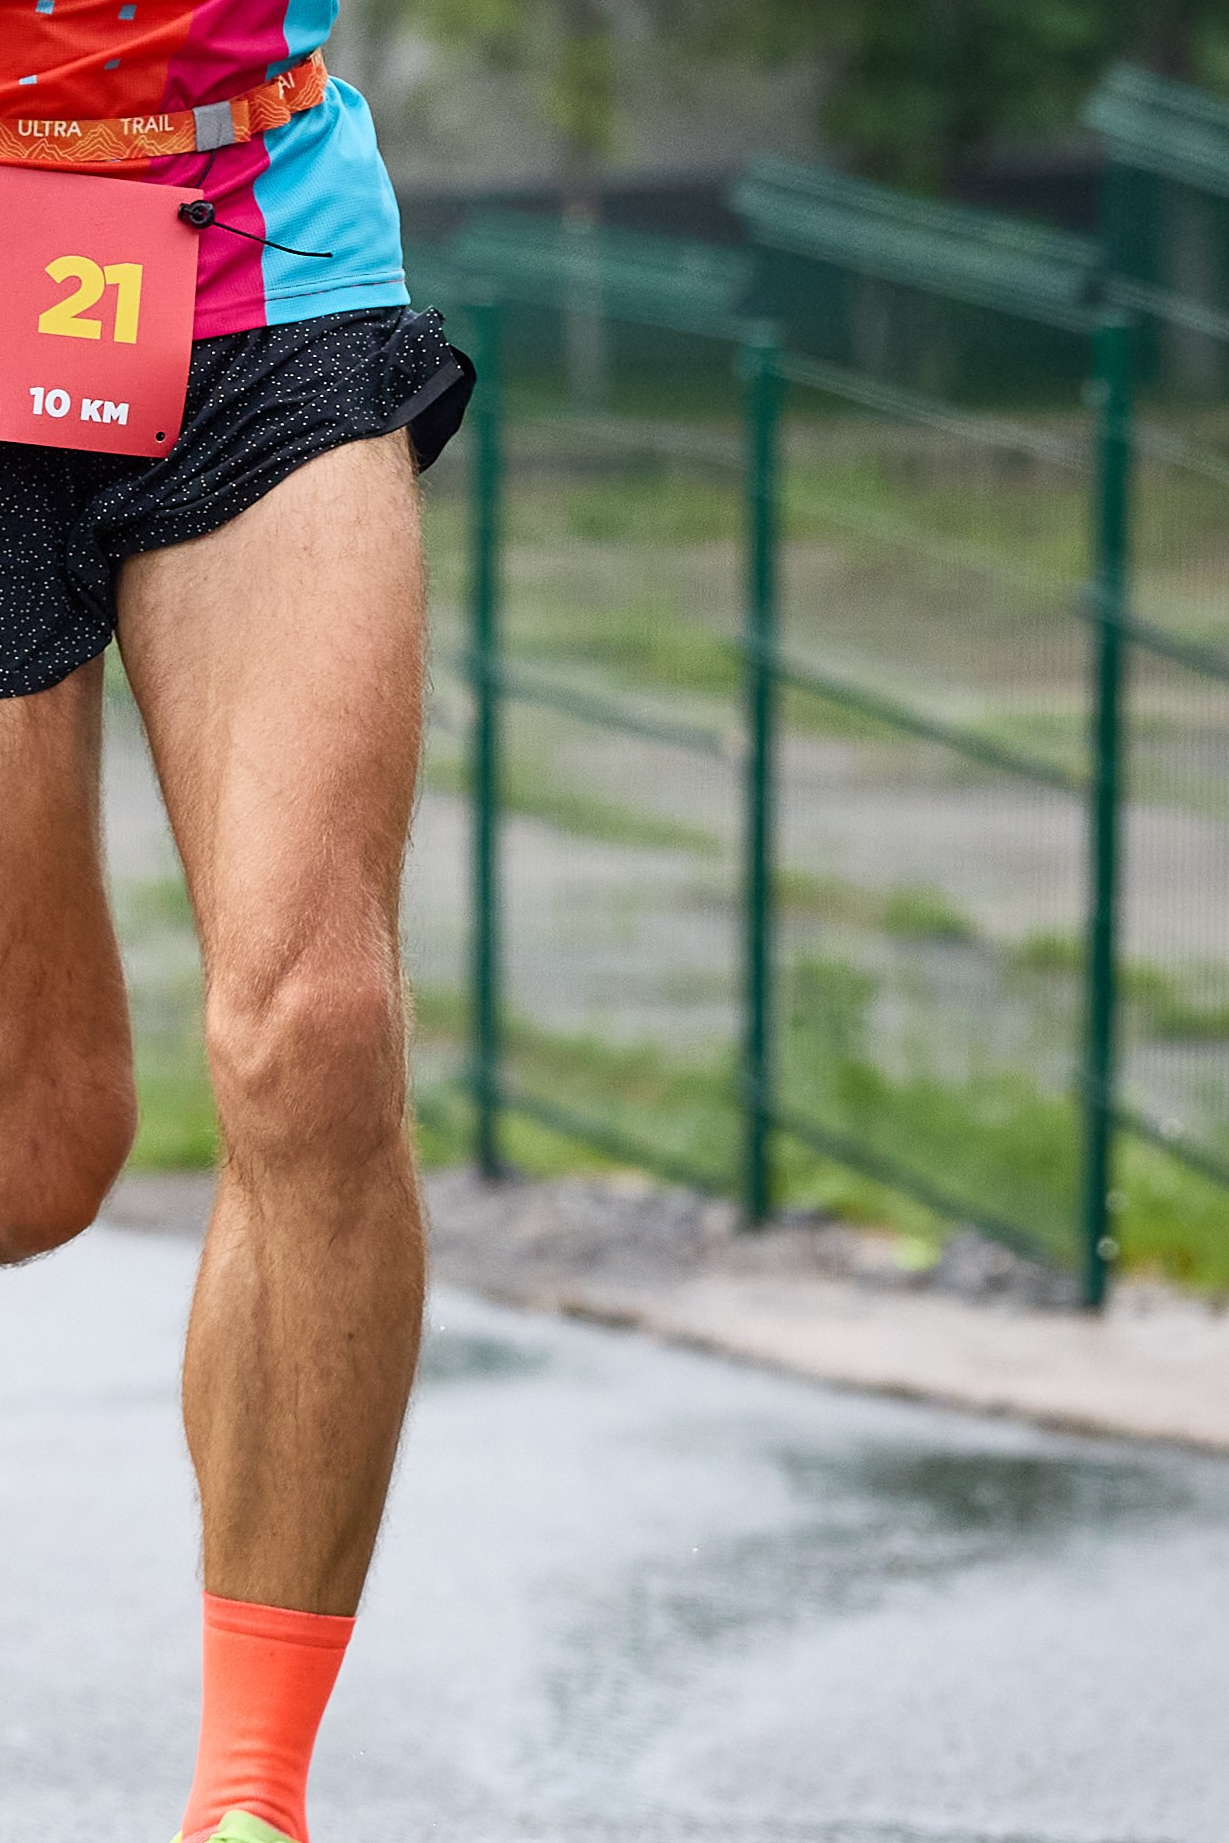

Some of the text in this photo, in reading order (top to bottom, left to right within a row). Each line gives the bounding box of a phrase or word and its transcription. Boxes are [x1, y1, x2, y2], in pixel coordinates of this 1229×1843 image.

[18, 119, 82, 137] ULTRA
[120, 115, 174, 135] TRAIL
[37, 255, 143, 344] 21
[30, 387, 71, 419] 10
